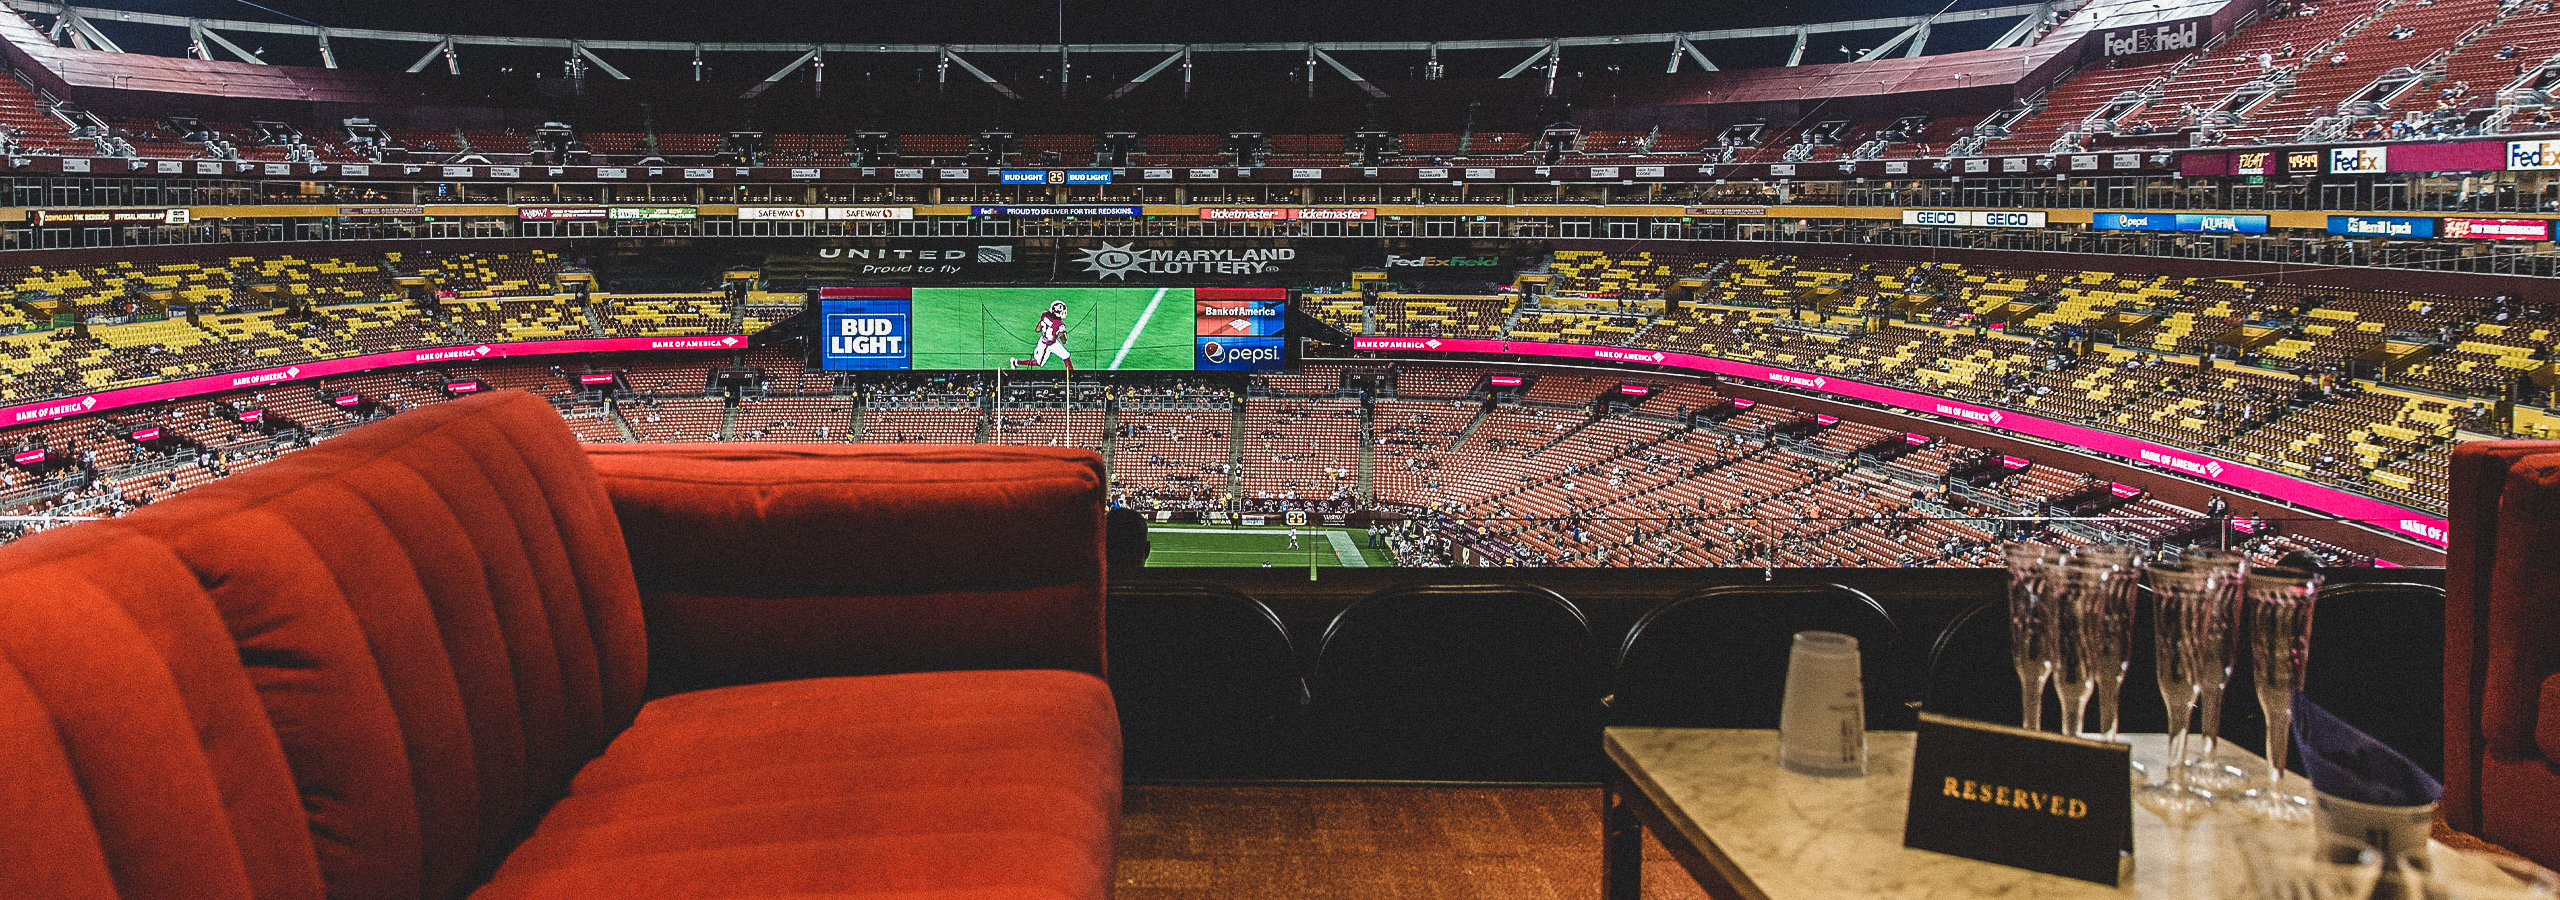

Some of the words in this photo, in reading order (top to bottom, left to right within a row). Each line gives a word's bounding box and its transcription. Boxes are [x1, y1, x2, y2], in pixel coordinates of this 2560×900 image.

[2104, 22, 2197, 56] FedExField
[2335, 151, 2377, 170] FedEx
[2512, 143, 2560, 167] FedEx
[1050, 172, 1063, 182] 25
[1917, 212, 1956, 223] GEICO
[1986, 213, 2028, 225] GEICO
[2127, 217, 2147, 227] pepsi
[819, 248, 966, 260] UNITED
[1151, 249, 1295, 261] MARYLAND
[1385, 254, 1499, 268] FedExField
[863, 265, 912, 273] Proud
[918, 265, 934, 273] to
[941, 265, 961, 274] fly
[1150, 261, 1268, 274] LOTTERY
[1206, 307, 1228, 316] Bank
[1229, 306, 1238, 316] of
[1239, 307, 1276, 316] America
[841, 318, 893, 336] BUD
[831, 336, 901, 354] LIGHT
[416, 353, 433, 362] BANK
[434, 352, 443, 360] OF
[443, 349, 475, 360] AMERICA
[1228, 345, 1280, 364] pepsi
[1595, 350, 1613, 358] BANK
[1624, 352, 1652, 361] AMERICA
[233, 376, 250, 386] BANK
[251, 375, 259, 384] OF
[259, 372, 287, 383] AMERICA
[1769, 373, 1784, 383] BANK
[1784, 374, 1791, 383] OF
[1790, 375, 1815, 387] AMERICA
[16, 410, 38, 421] BANK
[38, 407, 49, 417] OF
[49, 403, 82, 416] AMERICA
[1937, 404, 1953, 415] BANK
[1953, 407, 1962, 416] OF
[1962, 408, 1989, 422] AMERICA
[2140, 449, 2160, 462] BANK
[2161, 454, 2171, 466] OF
[2171, 456, 2206, 475] AMERICA
[1289, 513, 1303, 524] 25
[2400, 519, 2427, 536] BANK
[2428, 525, 2442, 539] OF
[1943, 776, 2088, 819] RESERVED
